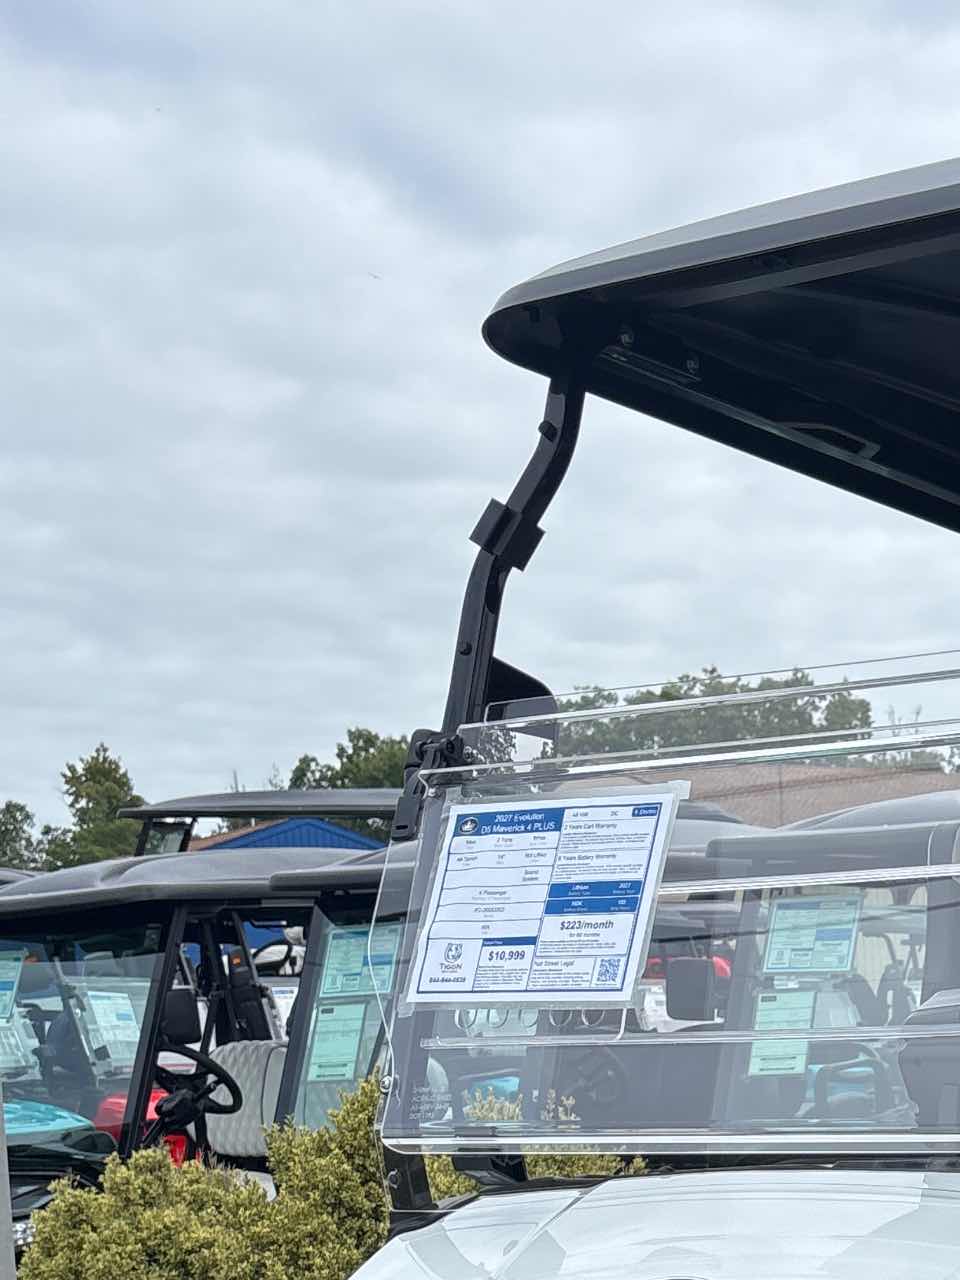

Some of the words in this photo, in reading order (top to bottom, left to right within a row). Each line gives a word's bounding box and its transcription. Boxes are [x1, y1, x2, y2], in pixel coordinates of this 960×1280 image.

[514, 813, 545, 822] Evolution
[492, 824, 525, 833] Maverick
[527, 823, 532, 831] 4
[533, 821, 556, 831] PLUS
[560, 920, 614, 931] $223/month
[488, 951, 526, 961] $10,999
